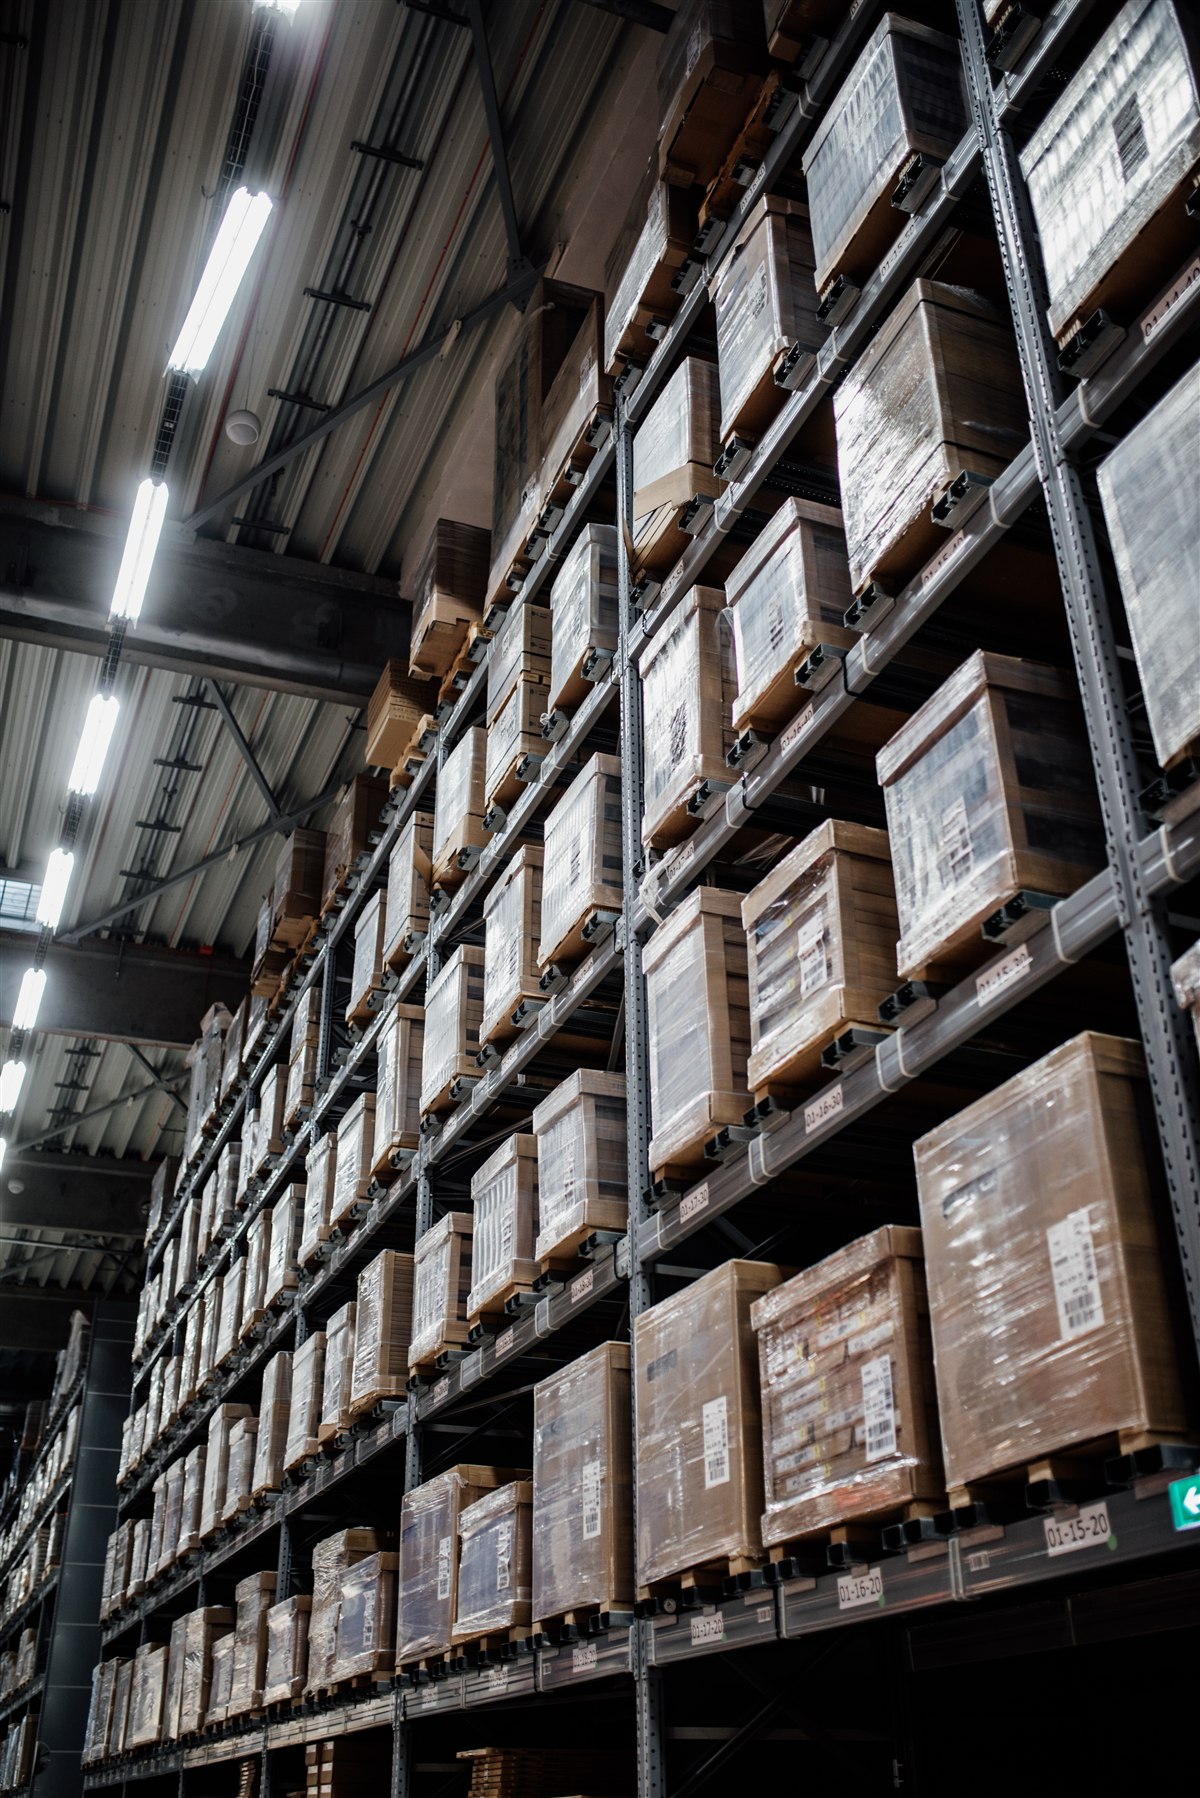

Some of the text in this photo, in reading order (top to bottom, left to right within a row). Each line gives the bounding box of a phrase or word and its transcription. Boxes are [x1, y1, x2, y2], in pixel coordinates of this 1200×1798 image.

[881, 224, 914, 277] 01-15-50
[781, 710, 813, 751] 01-16-40
[979, 953, 1027, 998] 01-15-30
[806, 1091, 842, 1128] 01-16-30
[680, 1189, 708, 1218] 01-17-30
[1047, 1513, 1108, 1548] 01-15-20
[839, 1577, 882, 1602] 01-16-20
[692, 1619, 723, 1639] 01-17-20
